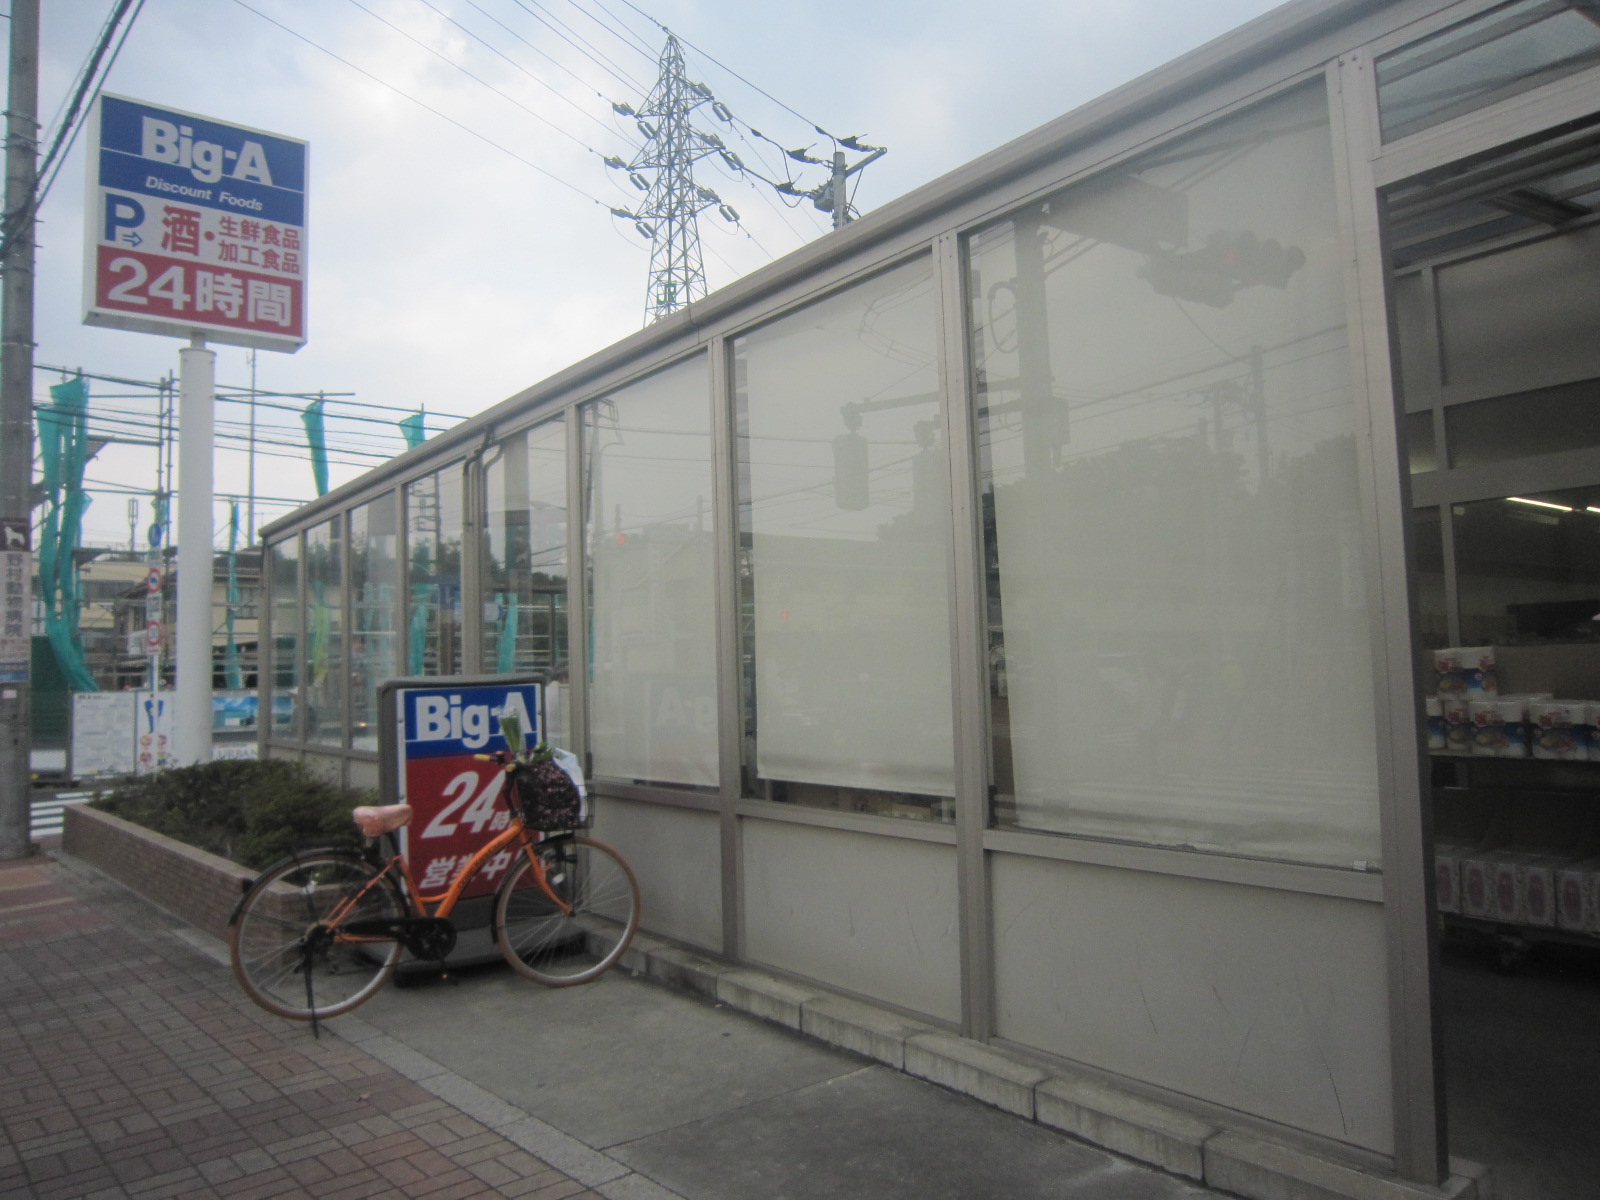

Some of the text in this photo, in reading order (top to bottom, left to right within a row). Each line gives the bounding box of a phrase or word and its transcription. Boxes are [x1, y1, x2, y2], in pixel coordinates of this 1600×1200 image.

[141, 115, 274, 184] Big-A
[145, 175, 263, 212] Discount Foods
[104, 192, 146, 243] P
[218, 215, 300, 251] 生鮮食品
[217, 239, 300, 275] 加工食品
[107, 256, 293, 328] 24時間
